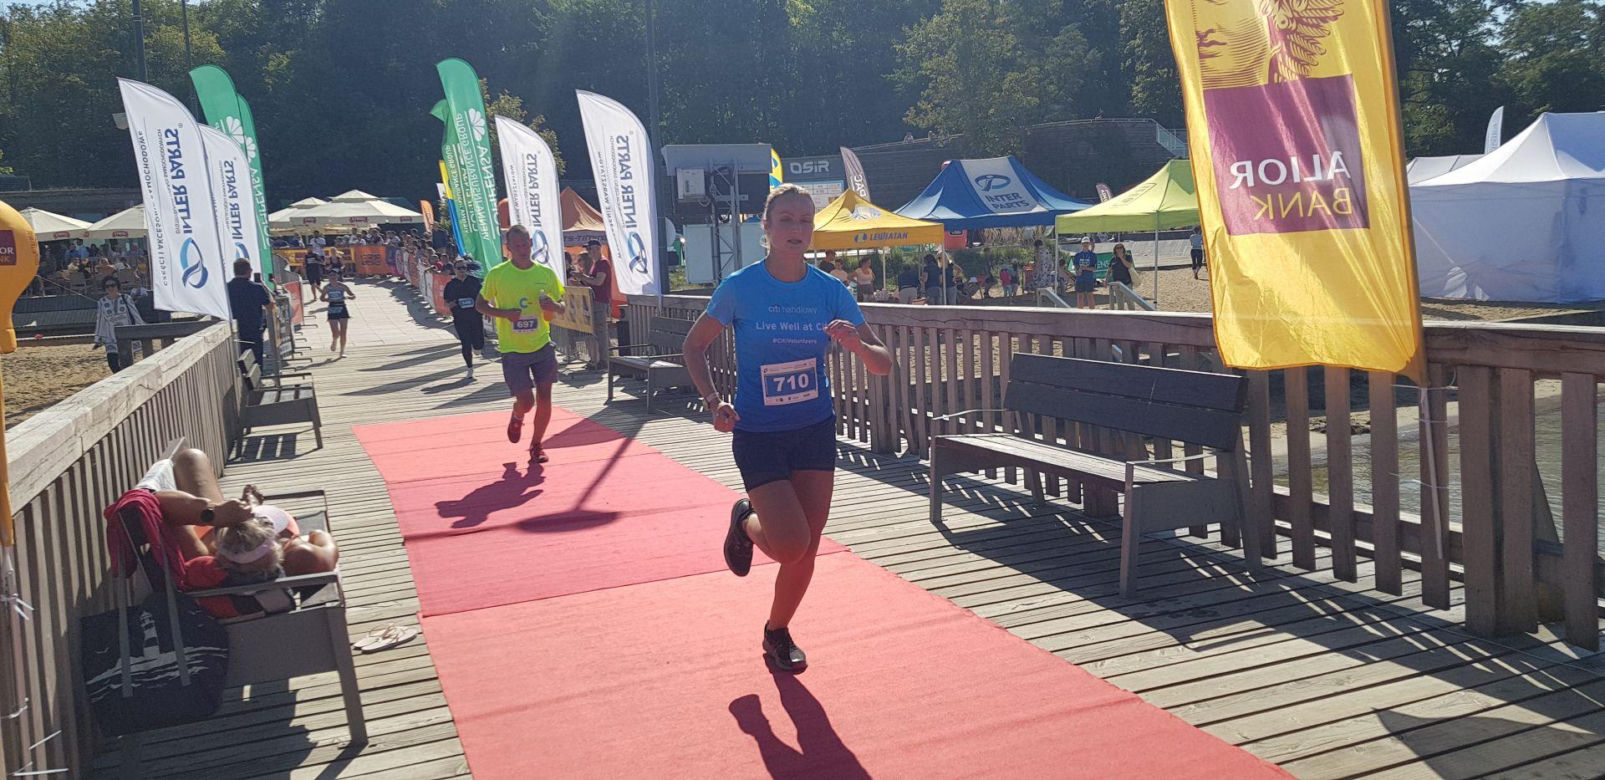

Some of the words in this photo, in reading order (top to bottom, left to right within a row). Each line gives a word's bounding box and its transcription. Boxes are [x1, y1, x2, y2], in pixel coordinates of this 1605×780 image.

[516, 320, 535, 329] 697
[756, 322, 777, 330] Live
[780, 322, 800, 331] Well
[802, 322, 814, 331] at
[773, 374, 809, 392] 710
